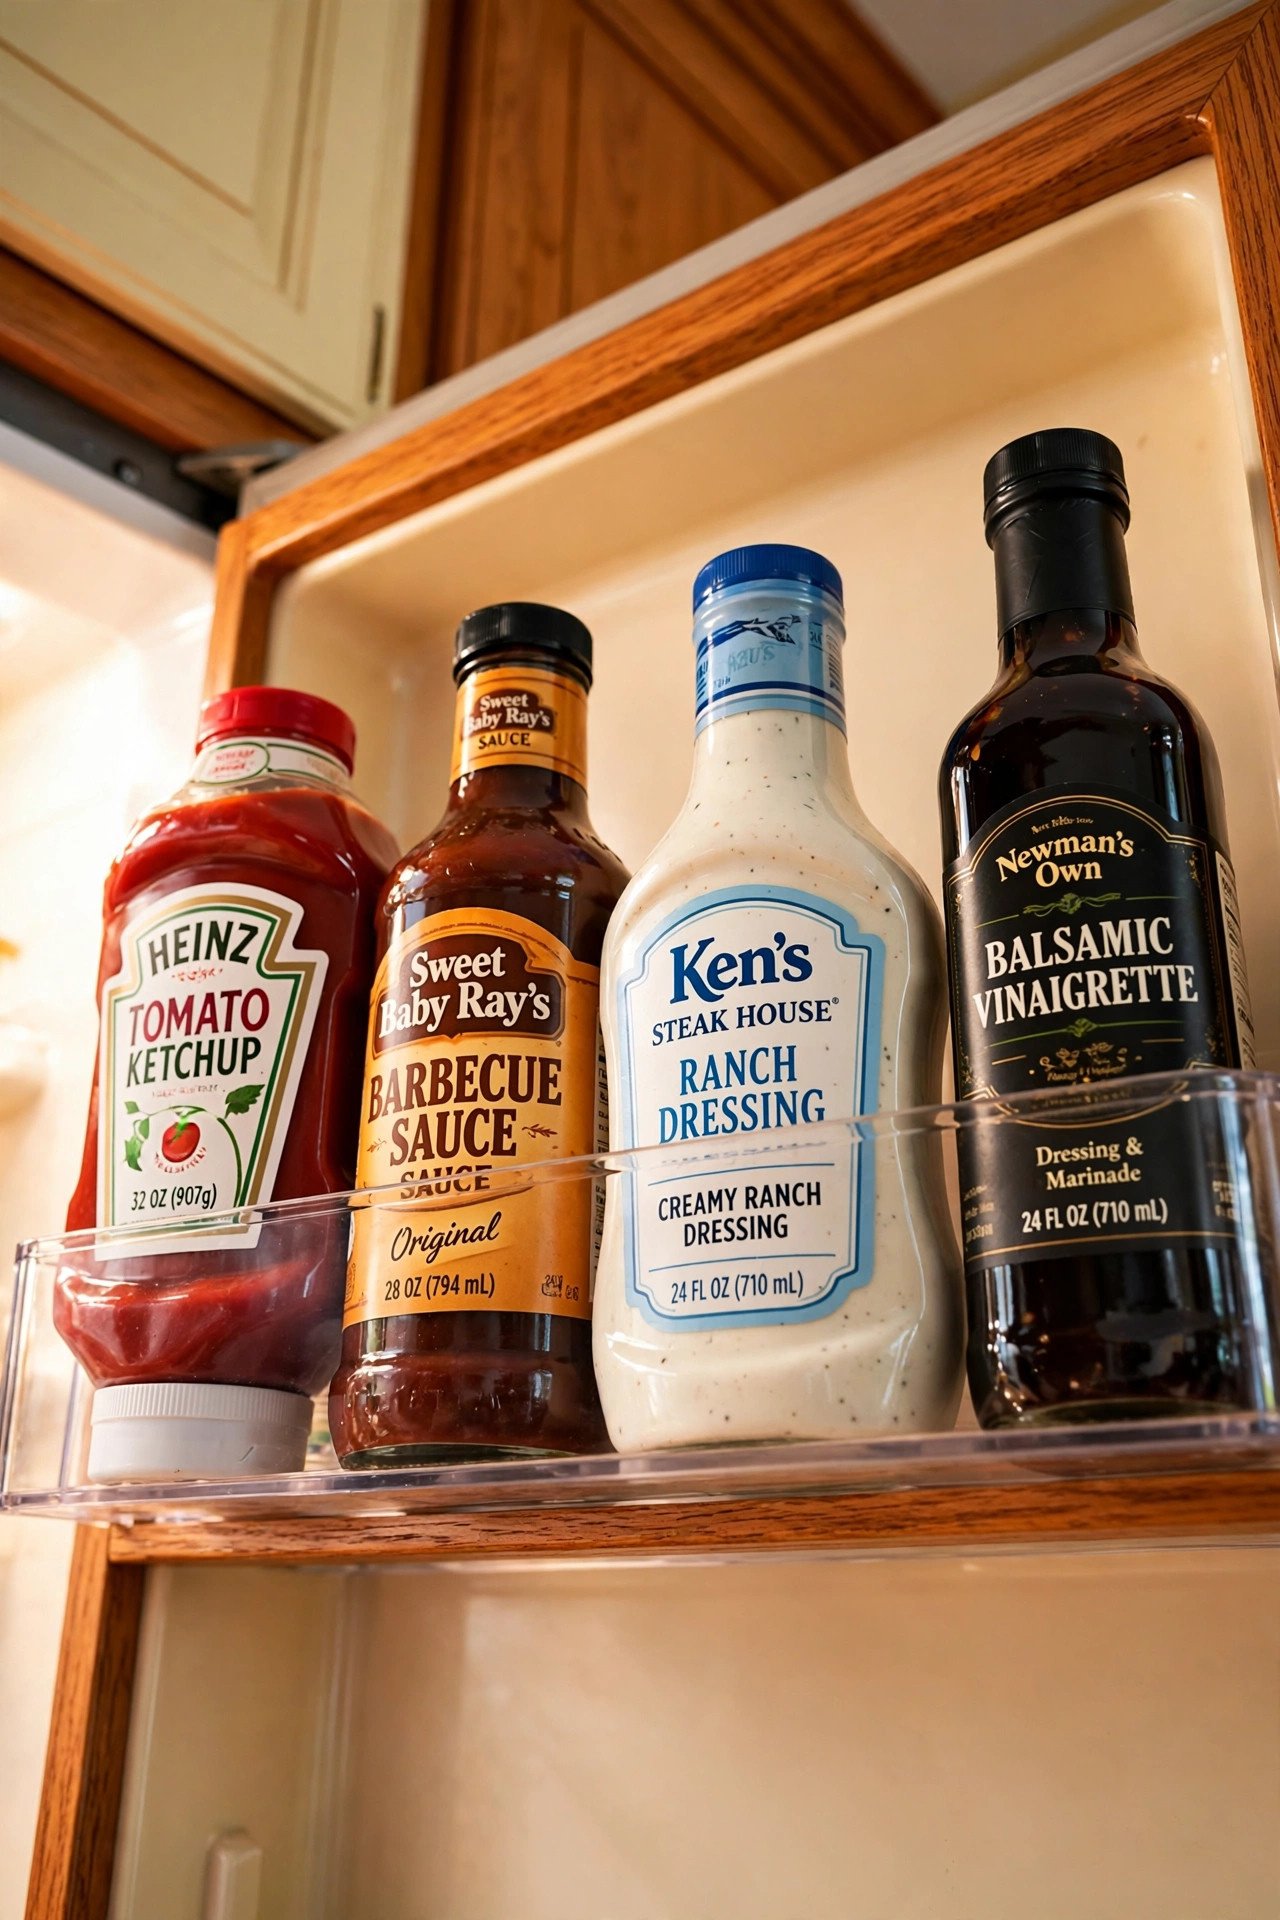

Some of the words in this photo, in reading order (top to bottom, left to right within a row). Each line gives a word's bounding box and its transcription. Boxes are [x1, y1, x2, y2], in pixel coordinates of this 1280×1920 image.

[480, 694, 528, 711] Sweet
[505, 708, 550, 729] Ray's
[478, 732, 531, 750] SAUCE
[995, 830, 1135, 882] Newman's
[1035, 860, 1103, 888] Own
[148, 920, 259, 976] HEINZ
[409, 946, 506, 987] Sweet
[669, 932, 813, 1004] Ken's
[984, 916, 1175, 979] BALSAMIC
[129, 987, 270, 1046] TOMATO
[378, 990, 450, 1038] Baby
[456, 982, 550, 1027] Ray's
[972, 965, 1199, 1029] VINAIGRETTE
[652, 1009, 729, 1046] STEAK
[126, 1036, 262, 1088] KETCHUP
[679, 1045, 797, 1097] RANCH
[368, 1053, 563, 1123] BARBECUE
[658, 1088, 826, 1145] DRESSING
[390, 1109, 518, 1167] SAUCE
[1035, 1137, 1122, 1167] Dressing
[1127, 1136, 1143, 1156] &
[131, 1190, 147, 1211] 32
[150, 1188, 168, 1210] OZ
[171, 1183, 217, 1211] (907g)
[400, 1165, 492, 1200] SAUCE
[1046, 1165, 1142, 1190] Marinade
[658, 1187, 737, 1222] CREAMY
[745, 1181, 822, 1210] RANCH
[1021, 1210, 1041, 1233] 24
[1046, 1208, 1065, 1230] FL
[1068, 1205, 1088, 1227] OZ
[1093, 1200, 1128, 1229] (710
[1134, 1198, 1168, 1225] mL)
[391, 1211, 502, 1264] Original
[683, 1214, 788, 1247] DRESSING
[385, 1279, 401, 1300] 28
[405, 1276, 422, 1298] OZ
[426, 1274, 460, 1300] (794
[464, 1272, 495, 1298] mL)
[671, 1281, 687, 1304] 24
[691, 1278, 707, 1302] FL
[711, 1276, 730, 1299] OZ
[734, 1273, 767, 1301] (710
[772, 1270, 804, 1298] mL)
